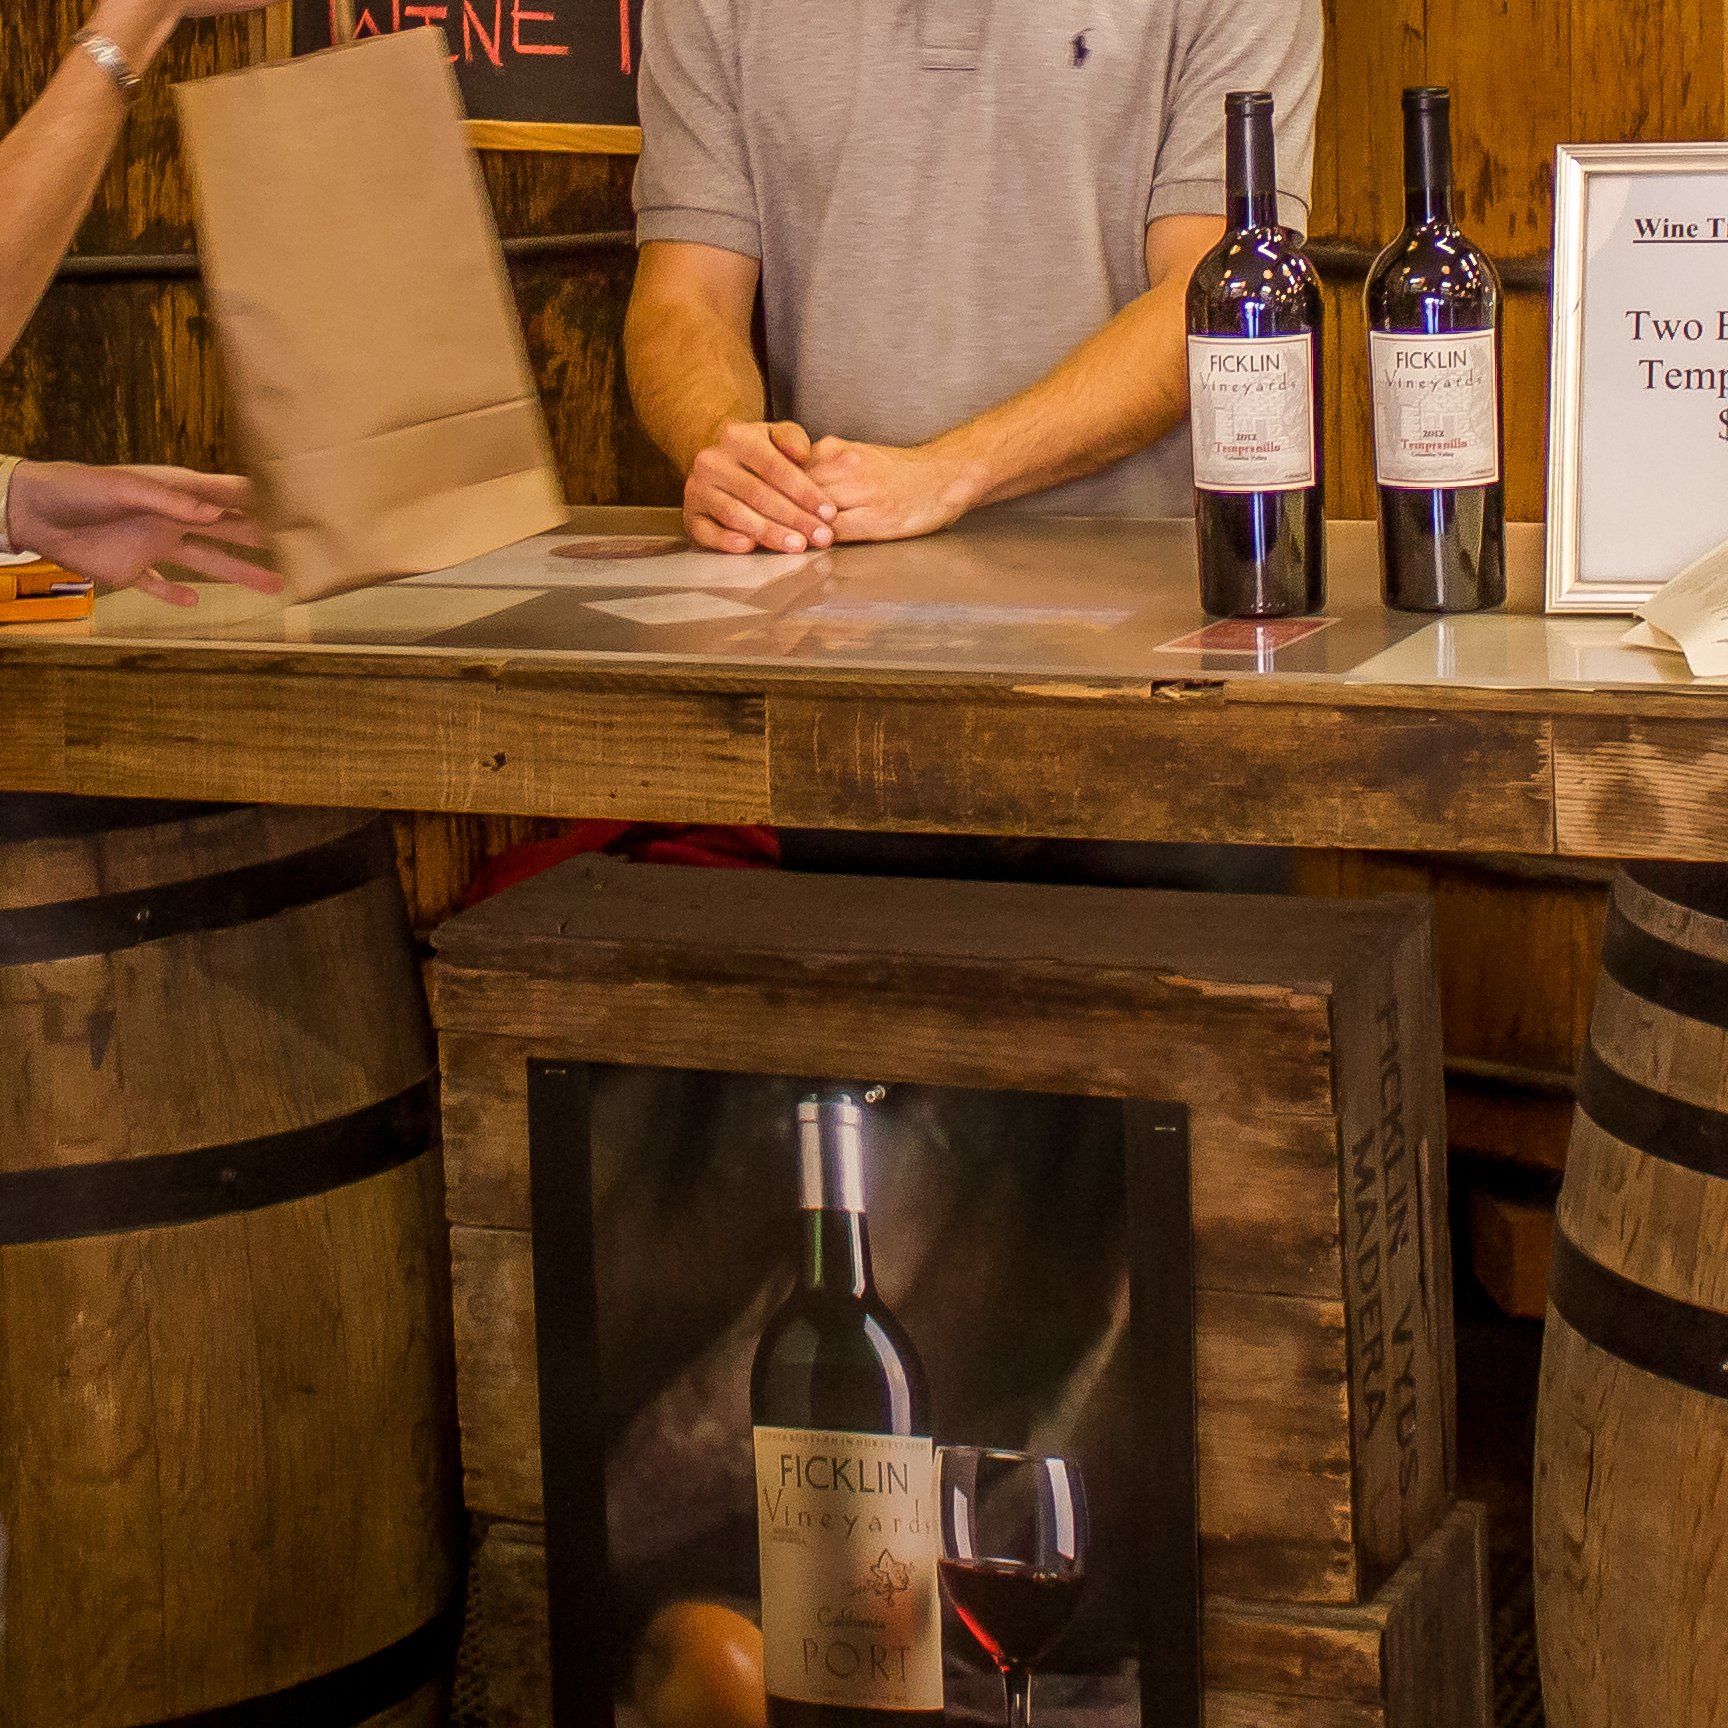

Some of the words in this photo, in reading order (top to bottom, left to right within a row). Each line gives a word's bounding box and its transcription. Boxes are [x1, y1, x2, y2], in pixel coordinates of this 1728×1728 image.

[1634, 218, 1698, 239] Wine
[1625, 310, 1703, 341] Two
[1210, 354, 1280, 372] FICKLIN
[1396, 349, 1467, 369] FICKLIN
[1200, 372, 1296, 396] Vineyards
[1385, 369, 1483, 393] Vineyards
[1215, 442, 1280, 456] Tempranillo
[1400, 438, 1467, 453] Tempranillo
[1375, 997, 1411, 1258] FICKLIN
[1352, 1130, 1386, 1440] MADERA
[780, 1454, 908, 1495] FICKLIN
[763, 1487, 930, 1540] Vineyards
[803, 1637, 910, 1684] PORT
